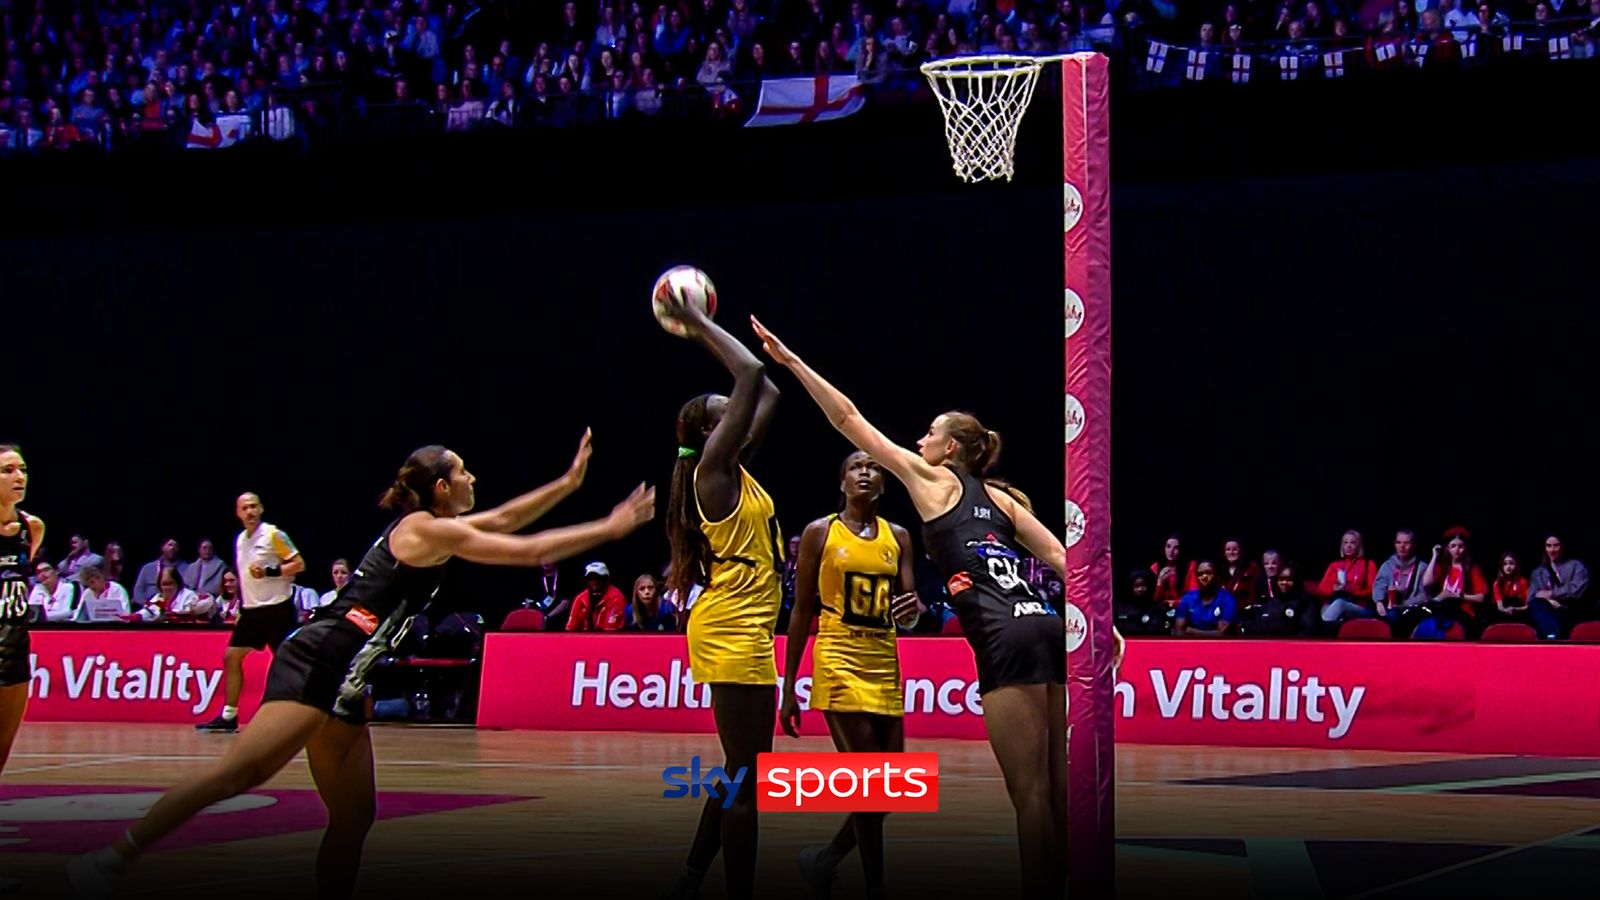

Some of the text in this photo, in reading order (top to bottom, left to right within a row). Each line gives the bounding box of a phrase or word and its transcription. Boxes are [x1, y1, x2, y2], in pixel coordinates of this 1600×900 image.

[850, 574, 891, 620] GA
[62, 653, 224, 715] Vitality
[1149, 666, 1366, 740] Vitality
